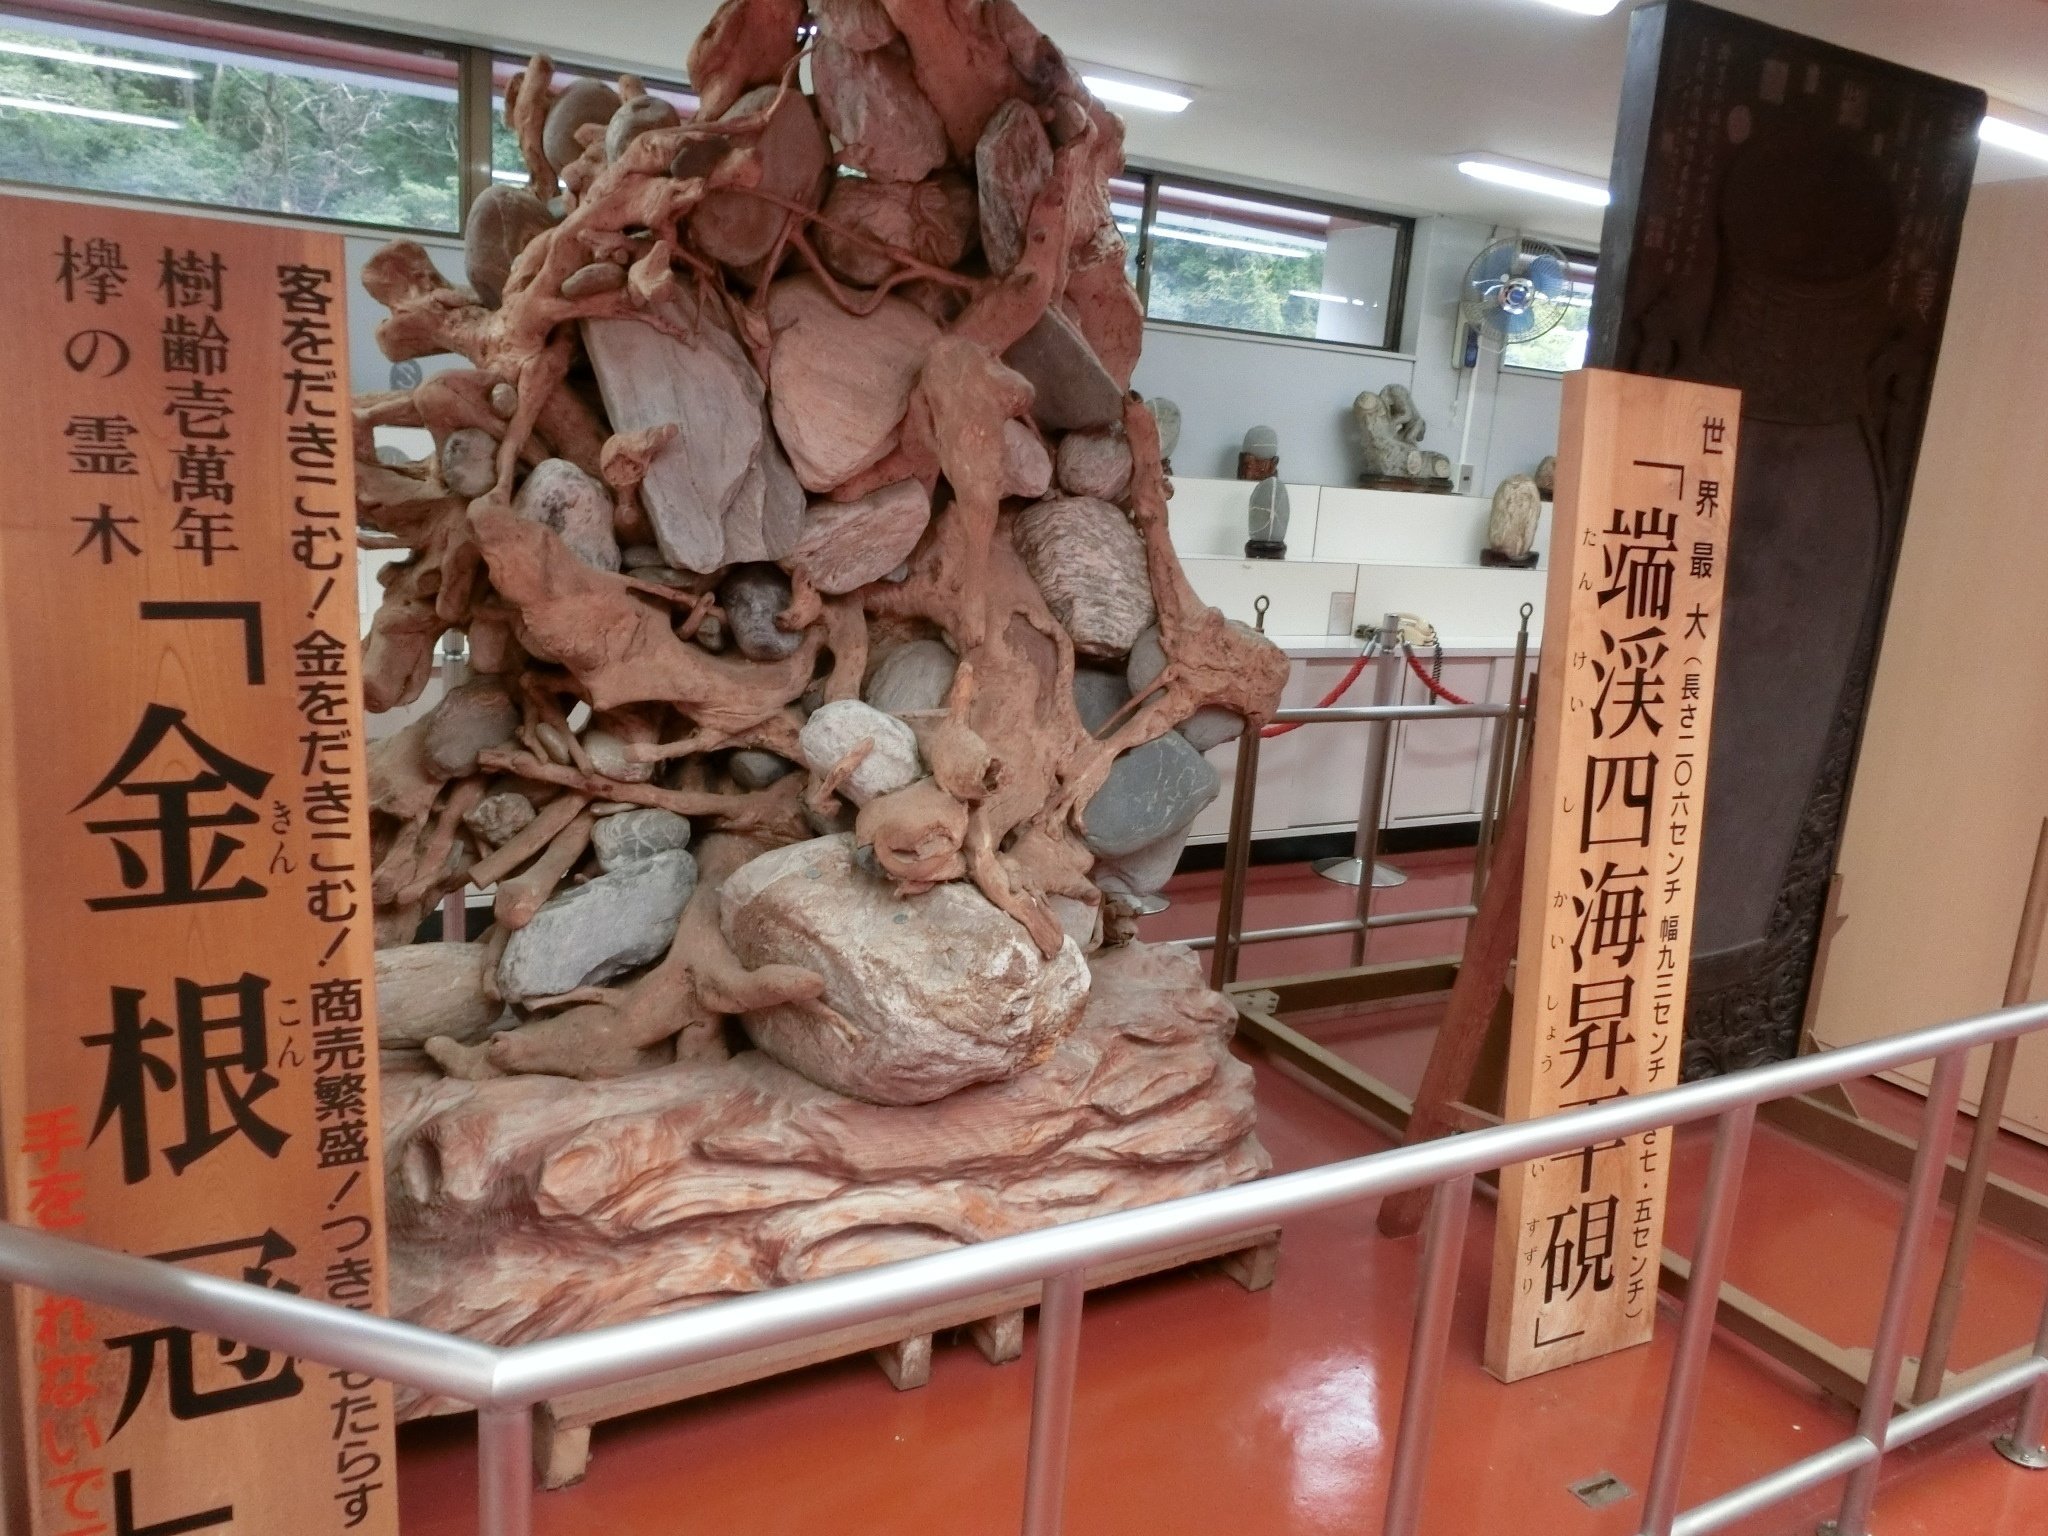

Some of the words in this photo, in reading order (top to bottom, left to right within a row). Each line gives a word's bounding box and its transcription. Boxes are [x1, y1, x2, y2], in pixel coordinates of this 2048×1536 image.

[157, 246, 239, 567] 樹齢壱萬年
[268, 799, 297, 876] きん
[276, 997, 306, 1070] こん
